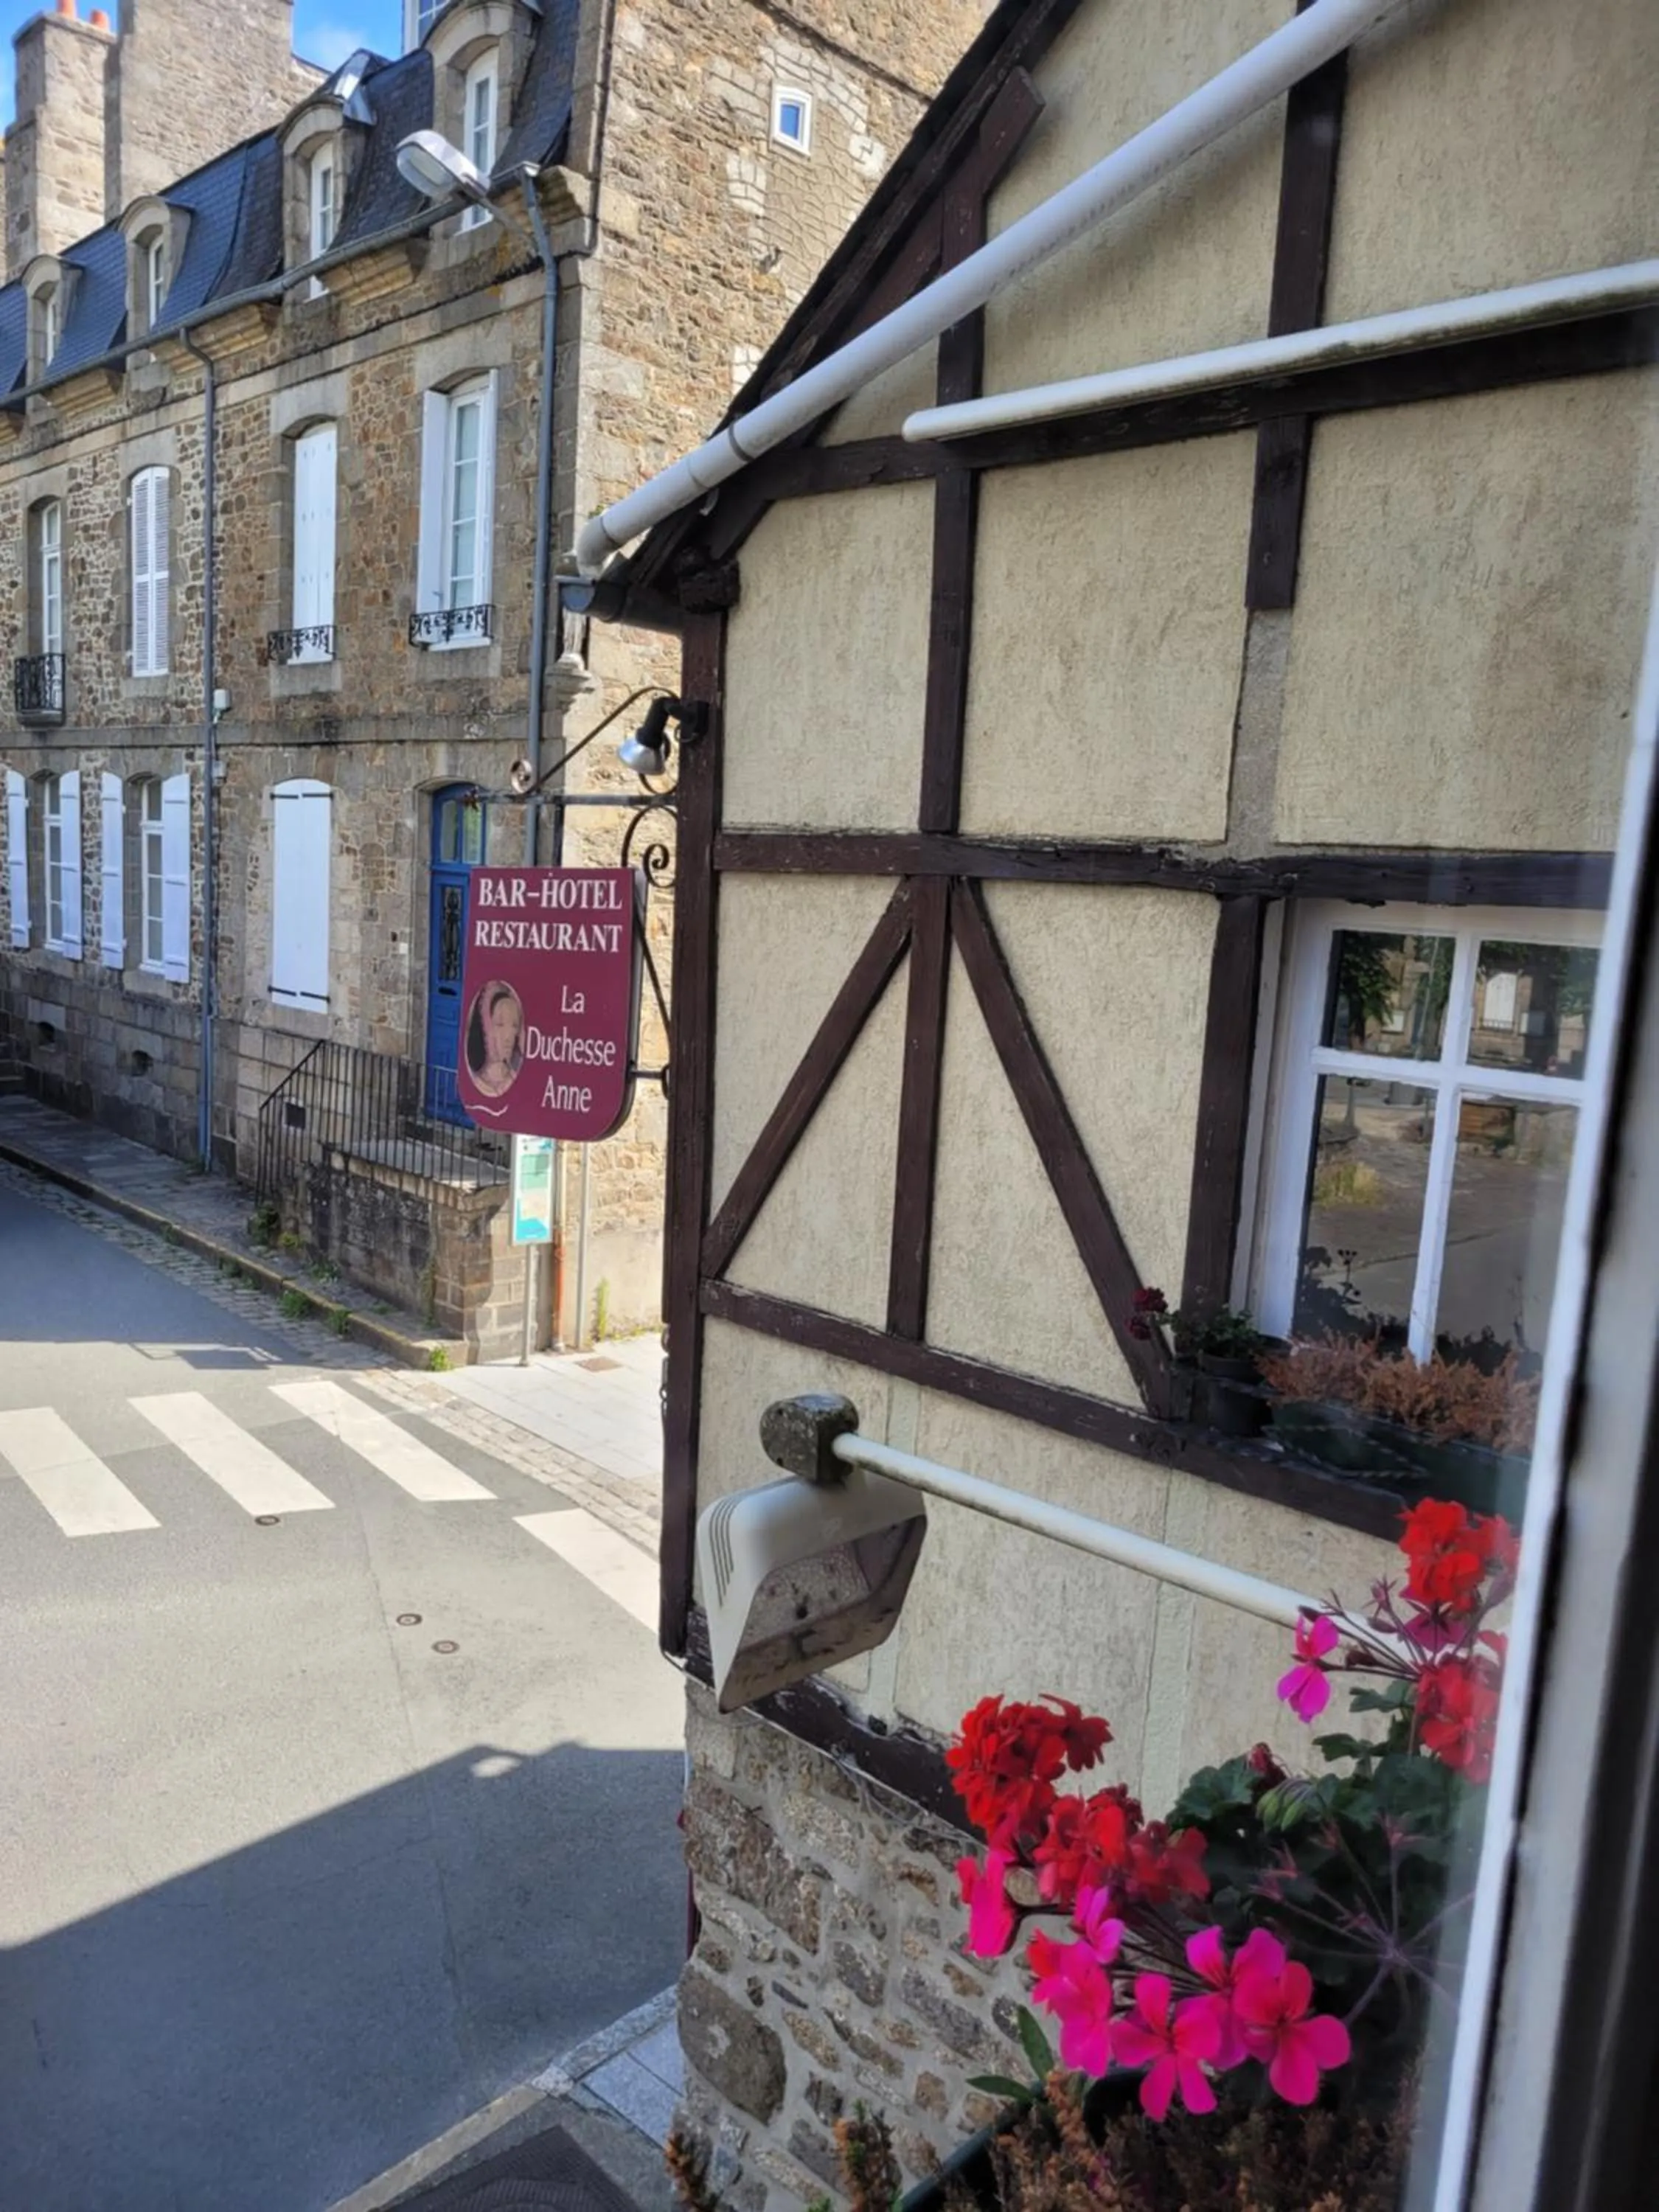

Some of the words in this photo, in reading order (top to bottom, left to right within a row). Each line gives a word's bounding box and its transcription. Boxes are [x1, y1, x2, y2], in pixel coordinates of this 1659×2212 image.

[474, 920, 622, 953] RESTAURANT
[561, 985, 585, 1014] La
[526, 1026, 616, 1066] Duchesse
[541, 1075, 592, 1113] Anne
